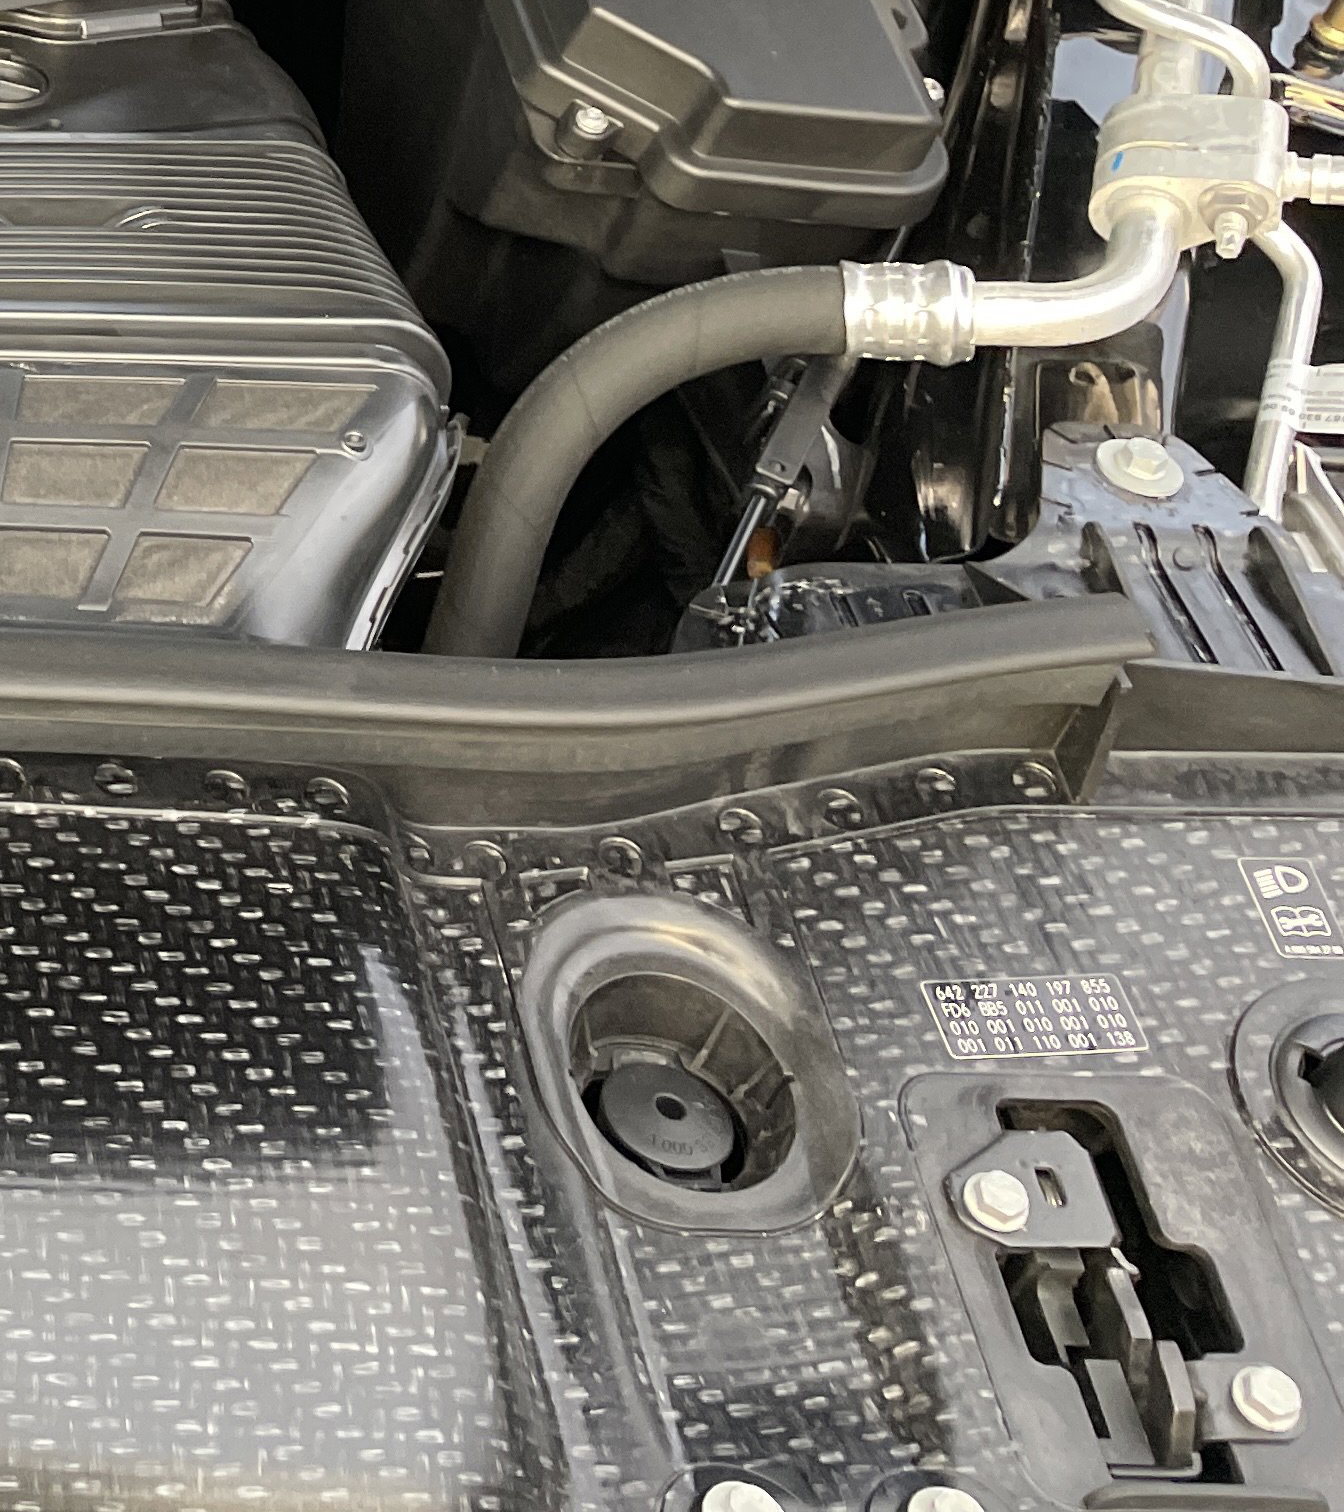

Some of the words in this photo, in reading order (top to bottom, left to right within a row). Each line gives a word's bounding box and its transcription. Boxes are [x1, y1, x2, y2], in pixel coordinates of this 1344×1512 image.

[936, 985, 964, 1001] 642
[971, 983, 998, 999] 227
[1009, 982, 1037, 998] 140
[1046, 980, 1071, 995] 197
[1080, 978, 1111, 994] 855
[1015, 999, 1046, 1015] 011
[1052, 998, 1082, 1014] 001
[1088, 996, 1118, 1012] 010
[950, 1020, 980, 1036] 010
[986, 1019, 1016, 1034] 001
[1023, 1016, 1053, 1033] 010
[1060, 1015, 1089, 1031] 001
[1097, 1013, 1127, 1029] 010
[957, 1038, 987, 1054] 001
[994, 1036, 1024, 1052] 011
[1033, 1034, 1061, 1050] 110
[1068, 1032, 1098, 1048] 001
[1106, 1031, 1136, 1046] 138
